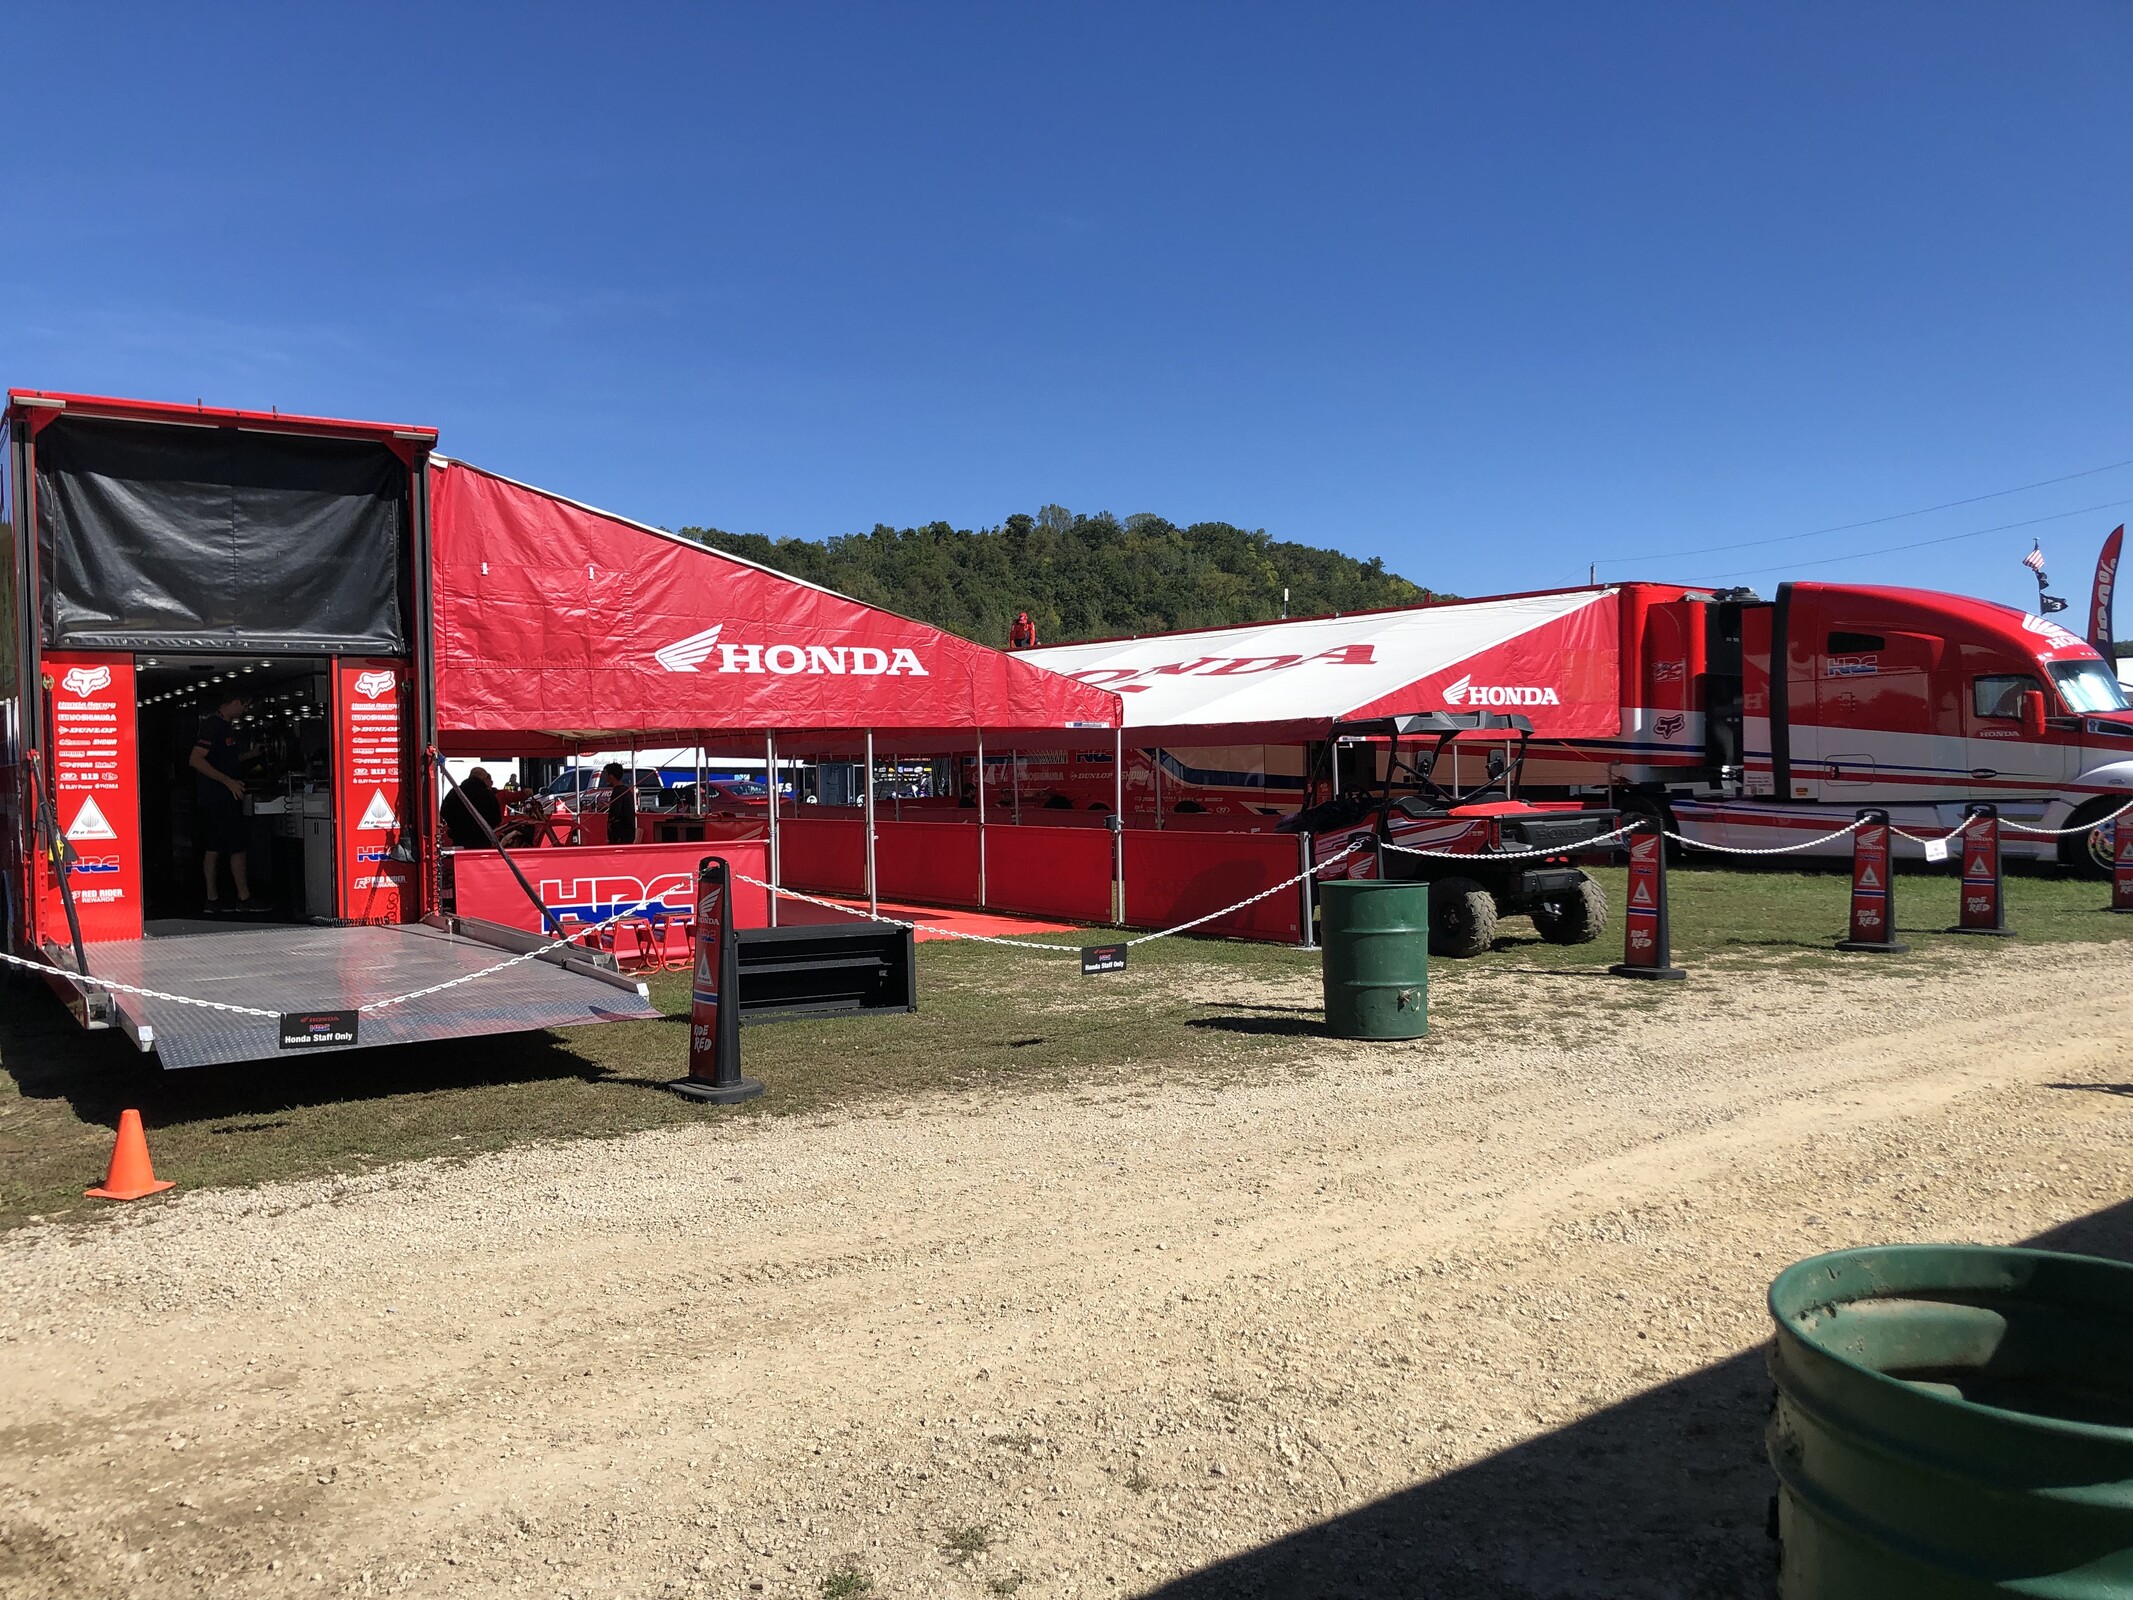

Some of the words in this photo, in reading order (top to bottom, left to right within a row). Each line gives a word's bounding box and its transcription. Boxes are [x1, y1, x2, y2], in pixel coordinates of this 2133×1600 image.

[717, 644, 929, 676] HONDA
[1062, 644, 1378, 693] ONDA
[1828, 655, 1877, 676] HRC
[1468, 686, 1561, 706] HONDA
[70, 713, 117, 721] YOSHIMURA
[1078, 772, 1113, 780] DUNLOP
[99, 889, 123, 897] RIDER
[540, 873, 695, 934] HRC
[1967, 896, 1987, 904] RIDE
[1857, 909, 1877, 917] RIDE
[1969, 903, 1990, 913] RED
[1858, 917, 1880, 927] RED
[1630, 929, 1649, 938] RIDE
[1632, 938, 1652, 949] RED
[1113, 960, 1125, 968] Only
[309, 1023, 331, 1032] HRC
[284, 1035, 311, 1044] Honda
[313, 1033, 333, 1041] Staff
[335, 1032, 353, 1041] Only
[695, 1037, 712, 1053] RED
